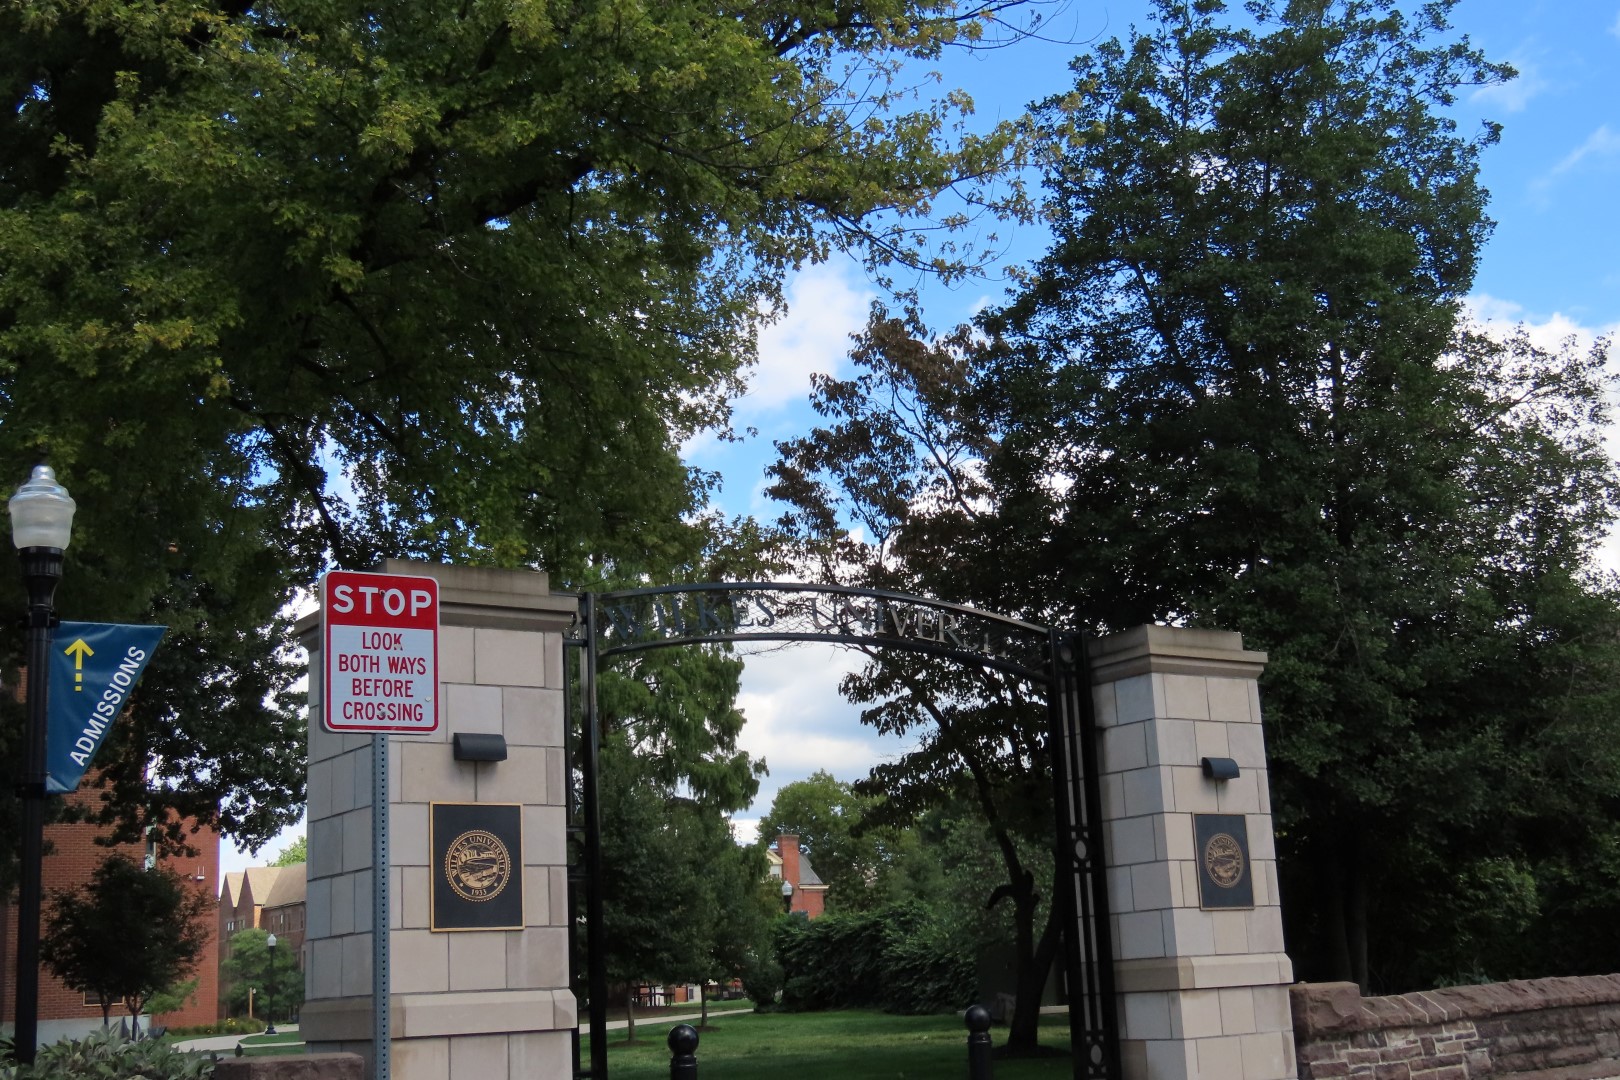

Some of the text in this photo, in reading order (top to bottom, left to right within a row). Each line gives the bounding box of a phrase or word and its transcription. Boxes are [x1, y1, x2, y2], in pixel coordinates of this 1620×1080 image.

[333, 585, 432, 617] STOP
[604, 592, 775, 640] WILKES
[362, 631, 403, 651] LOOK
[338, 654, 427, 675] BOTH WAYS
[352, 678, 414, 698] BEFORE
[69, 646, 146, 767] ADMISSIONS
[343, 701, 423, 722] CROSSING
[450, 835, 506, 878] WILKES UNIVERSITY
[471, 888, 487, 896] 1933
